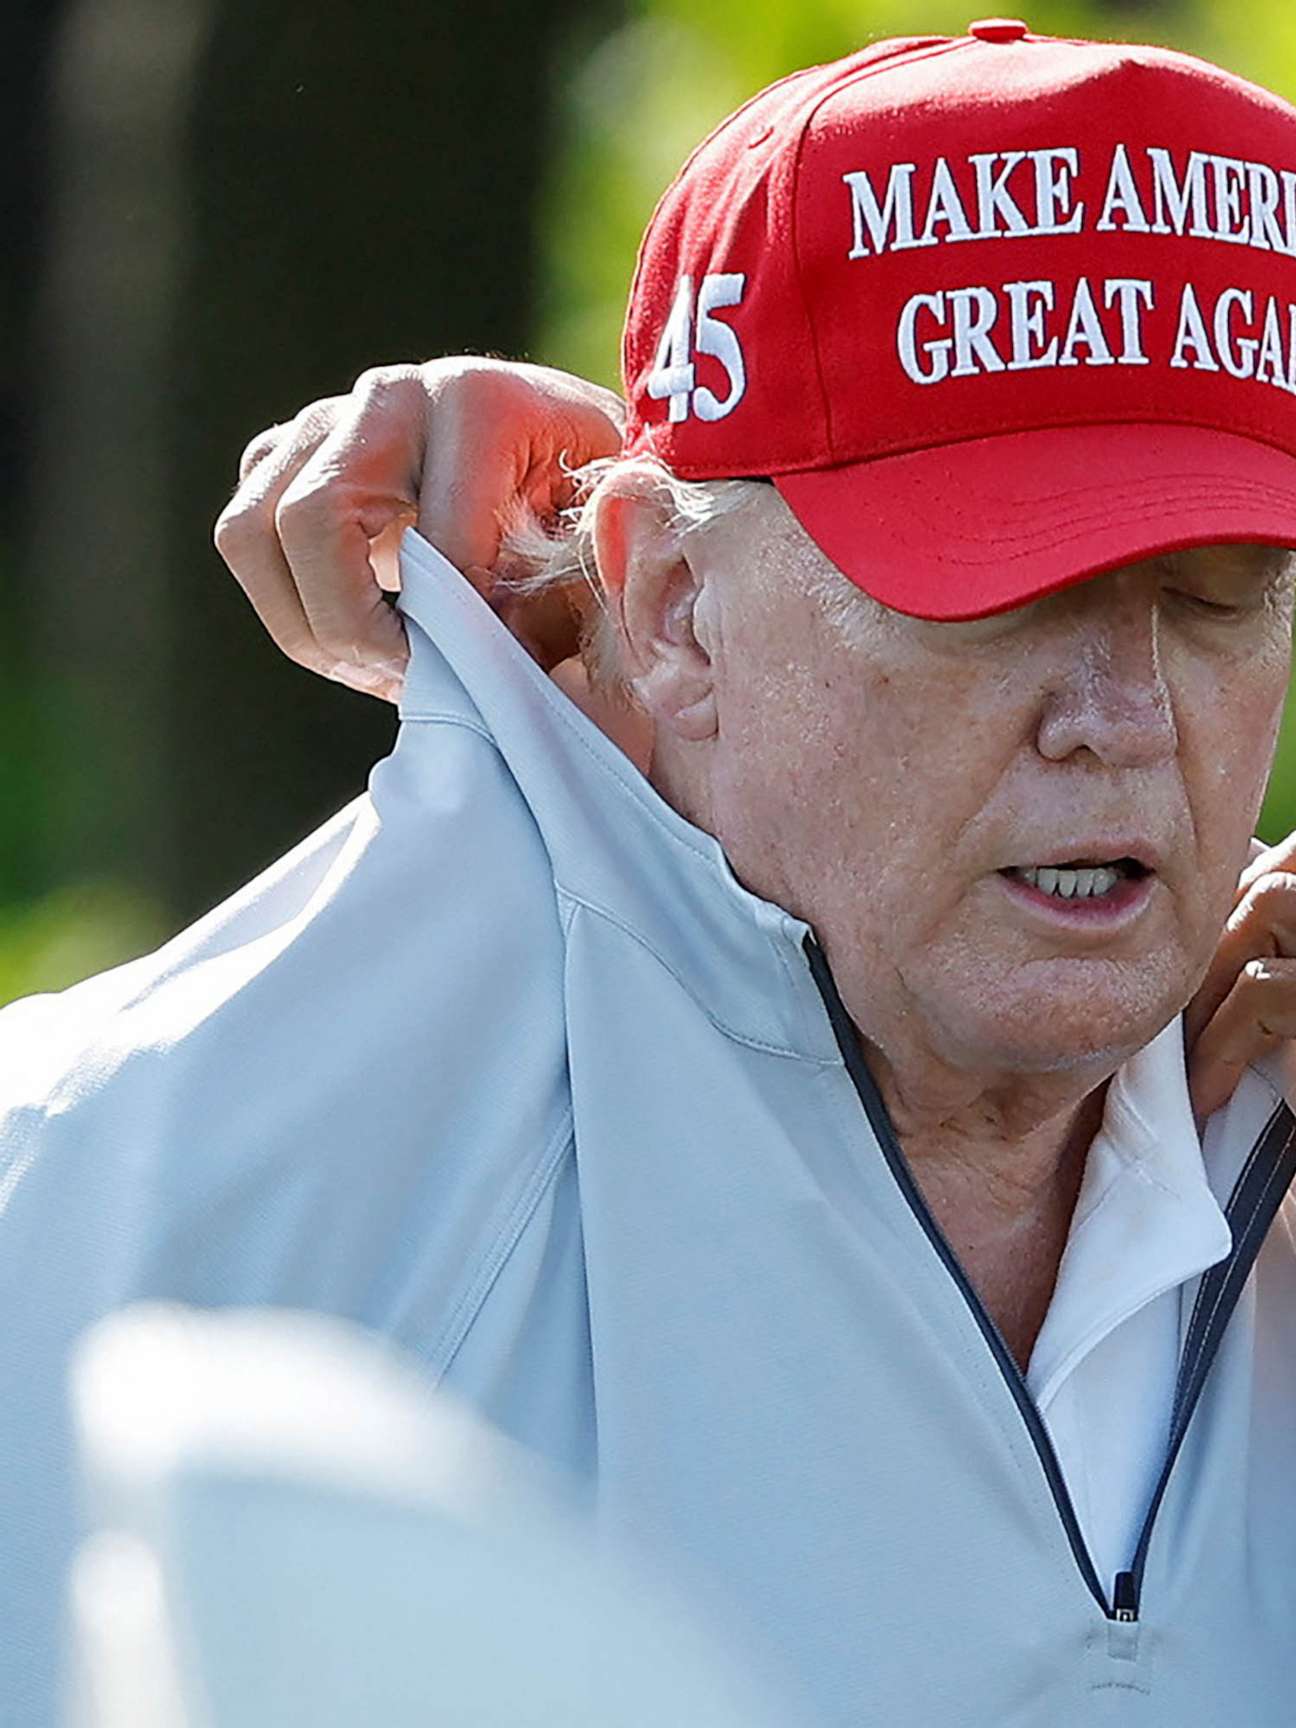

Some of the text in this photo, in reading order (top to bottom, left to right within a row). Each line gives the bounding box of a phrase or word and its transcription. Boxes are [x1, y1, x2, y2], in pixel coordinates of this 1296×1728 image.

[843, 147, 1084, 260] MAKE
[647, 273, 748, 424] 45
[896, 276, 1155, 386] GREAT
